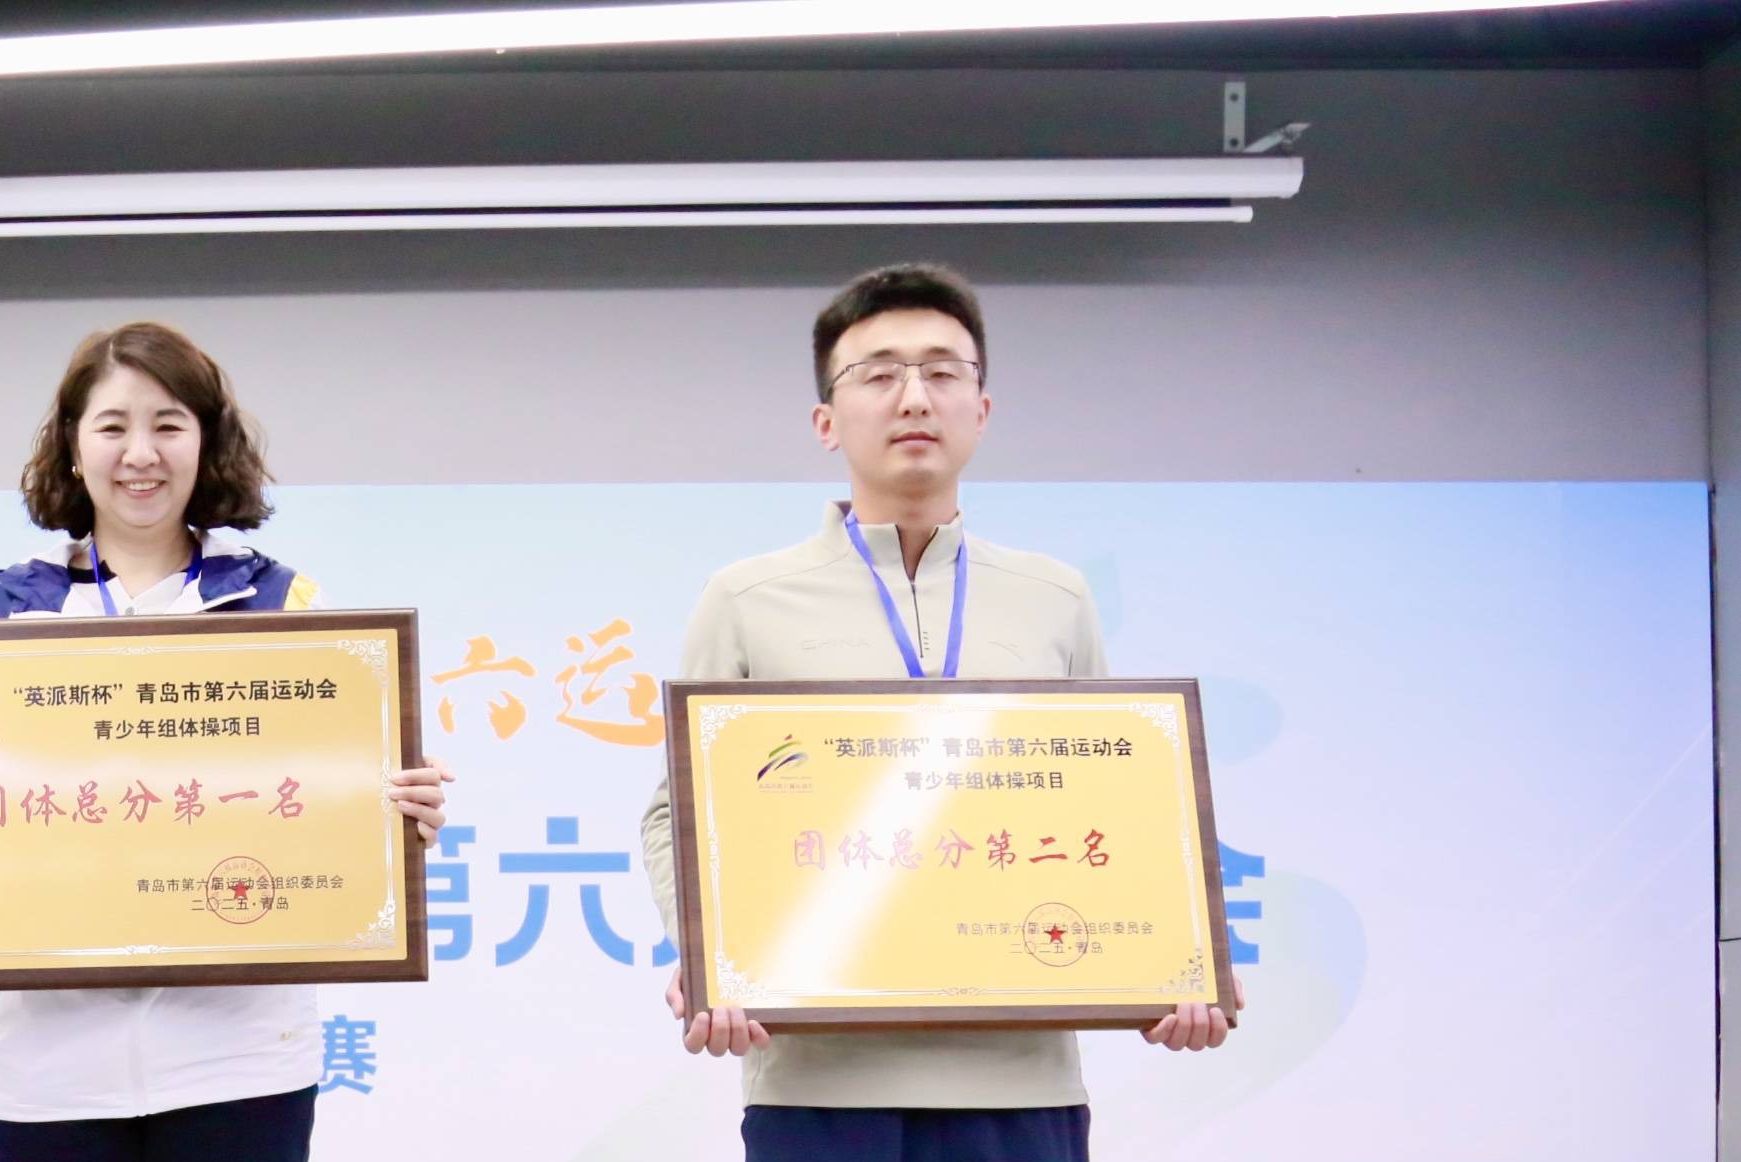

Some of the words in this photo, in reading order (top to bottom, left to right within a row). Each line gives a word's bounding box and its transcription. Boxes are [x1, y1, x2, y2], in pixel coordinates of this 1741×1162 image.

[94, 716, 261, 739] 青少年组体操项目
[904, 771, 1064, 790] 青少年组体操项目
[793, 829, 1112, 870] 团体总分第二名
